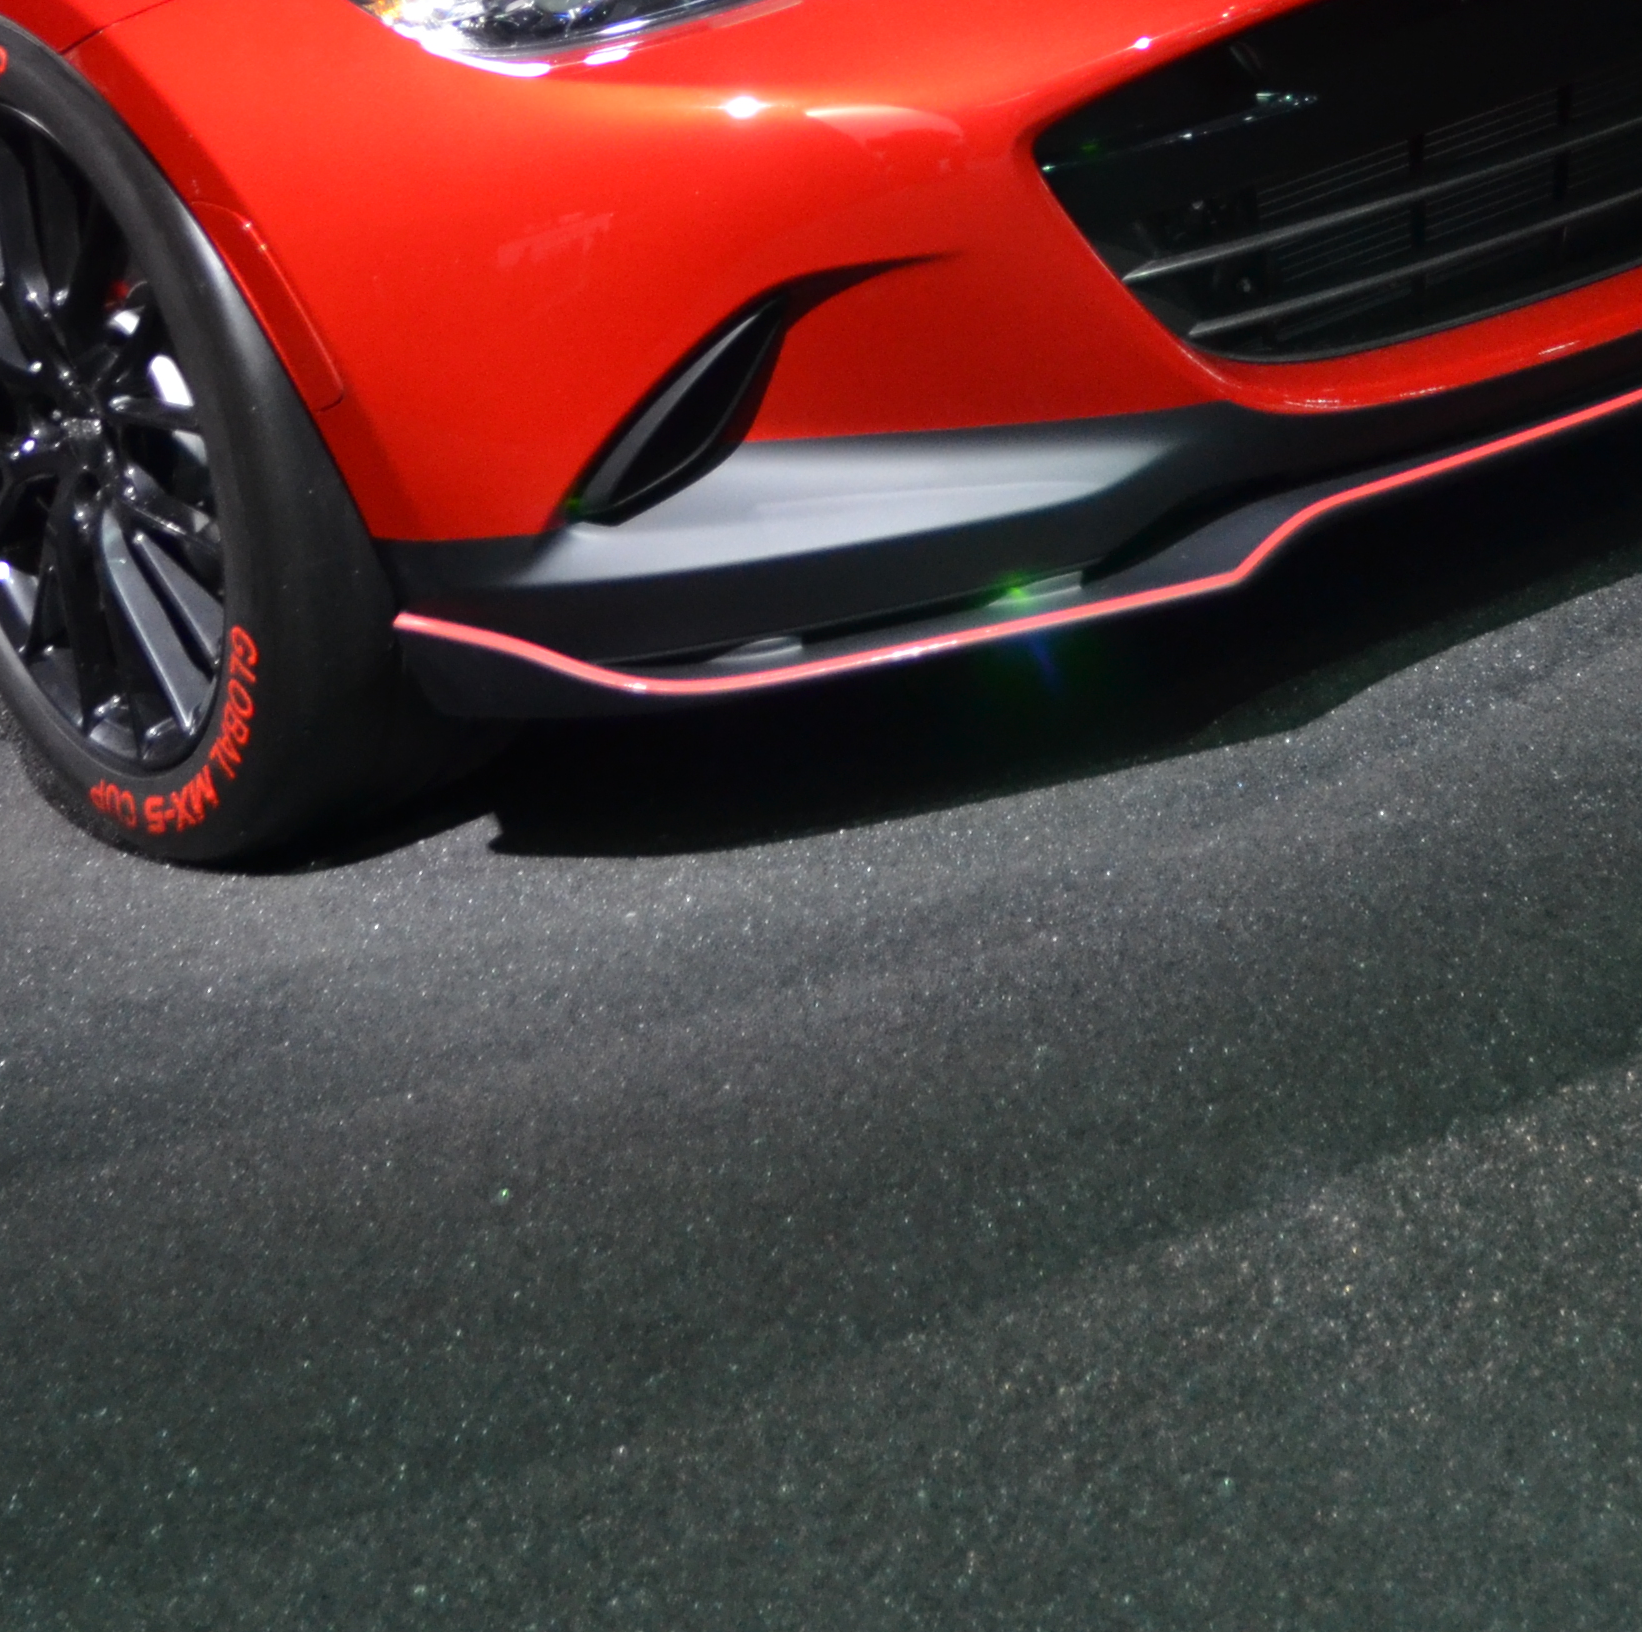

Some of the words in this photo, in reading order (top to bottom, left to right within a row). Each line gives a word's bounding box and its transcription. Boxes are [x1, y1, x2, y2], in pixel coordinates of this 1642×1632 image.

[210, 624, 259, 779] GLOBAL
[89, 779, 137, 829] CUP
[143, 764, 219, 835] MX-5
